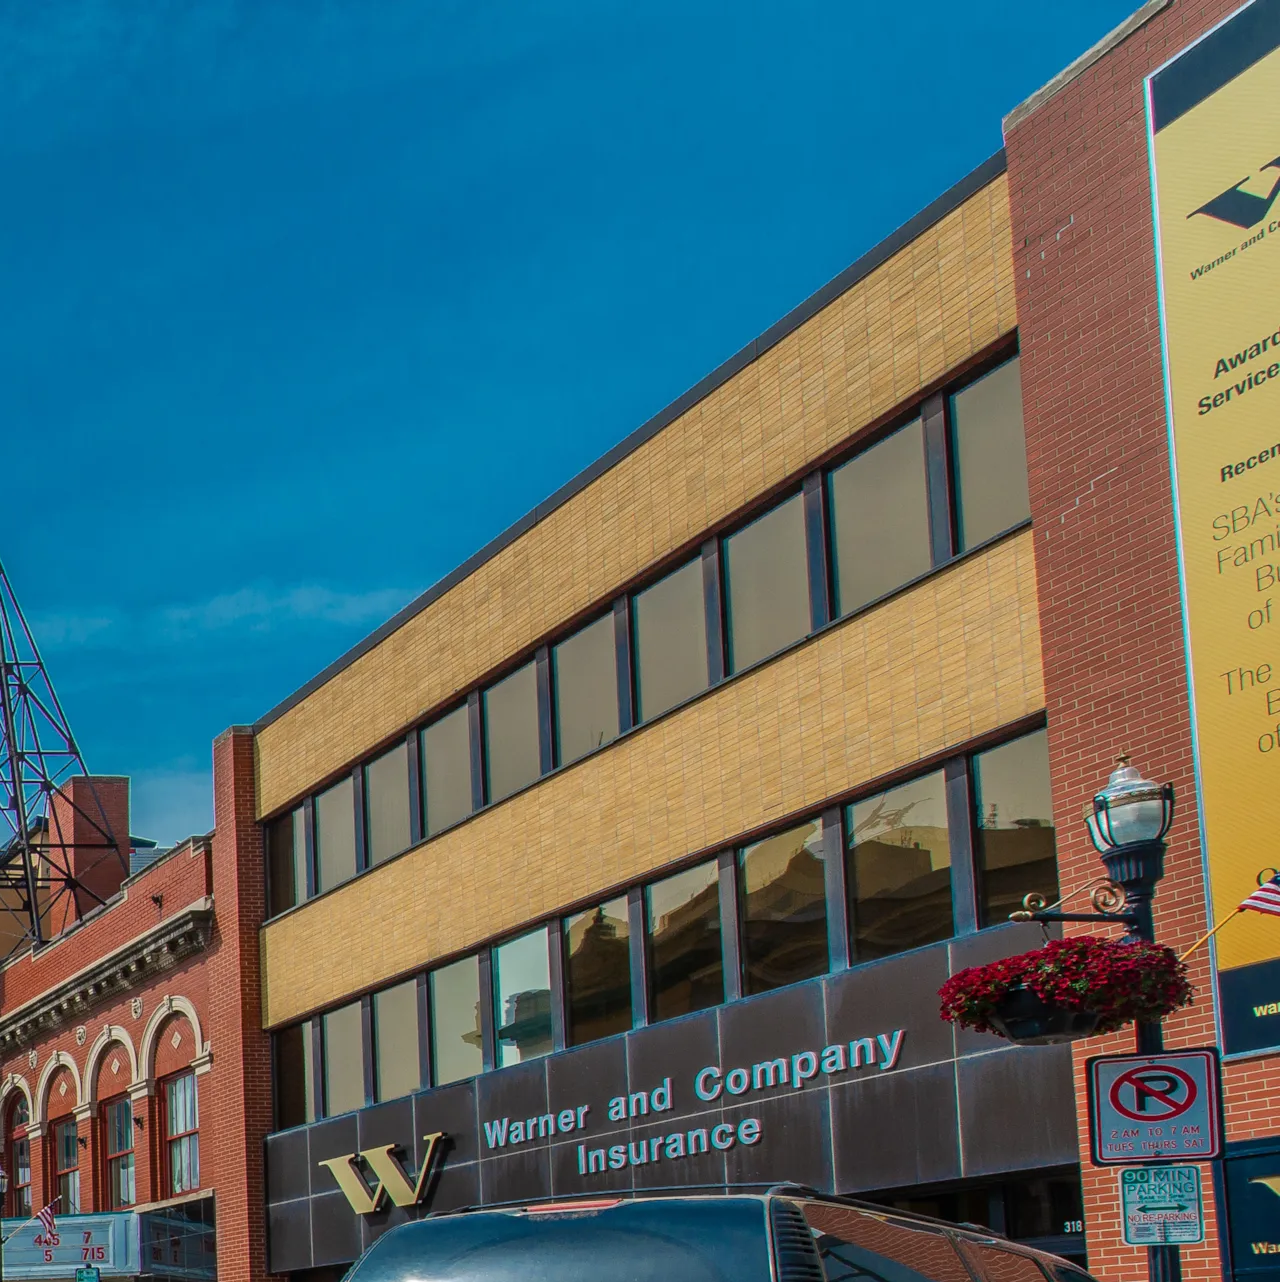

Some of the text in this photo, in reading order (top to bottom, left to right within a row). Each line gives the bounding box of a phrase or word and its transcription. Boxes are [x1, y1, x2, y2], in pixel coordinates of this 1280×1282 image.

[1190, 219, 1280, 281] Warner and C
[1247, 597, 1273, 631] of
[1219, 662, 1272, 696] The
[483, 1028, 906, 1150] Warner and Company
[1111, 1125, 1200, 1139] 2 AM TO 7 AM
[577, 1117, 762, 1176] Insurance
[1107, 1138, 1204, 1152] TUES THURS SAT
[318, 1130, 449, 1215] W
[1124, 1169, 1192, 1182] 90 MIN
[1126, 1182, 1195, 1195] PARKING
[1128, 1213, 1197, 1222] NO RE-PARKING
[1063, 1220, 1083, 1233] 318
[83, 1231, 92, 1244] 7
[44, 1249, 53, 1263] 5
[82, 1247, 105, 1261] 715
